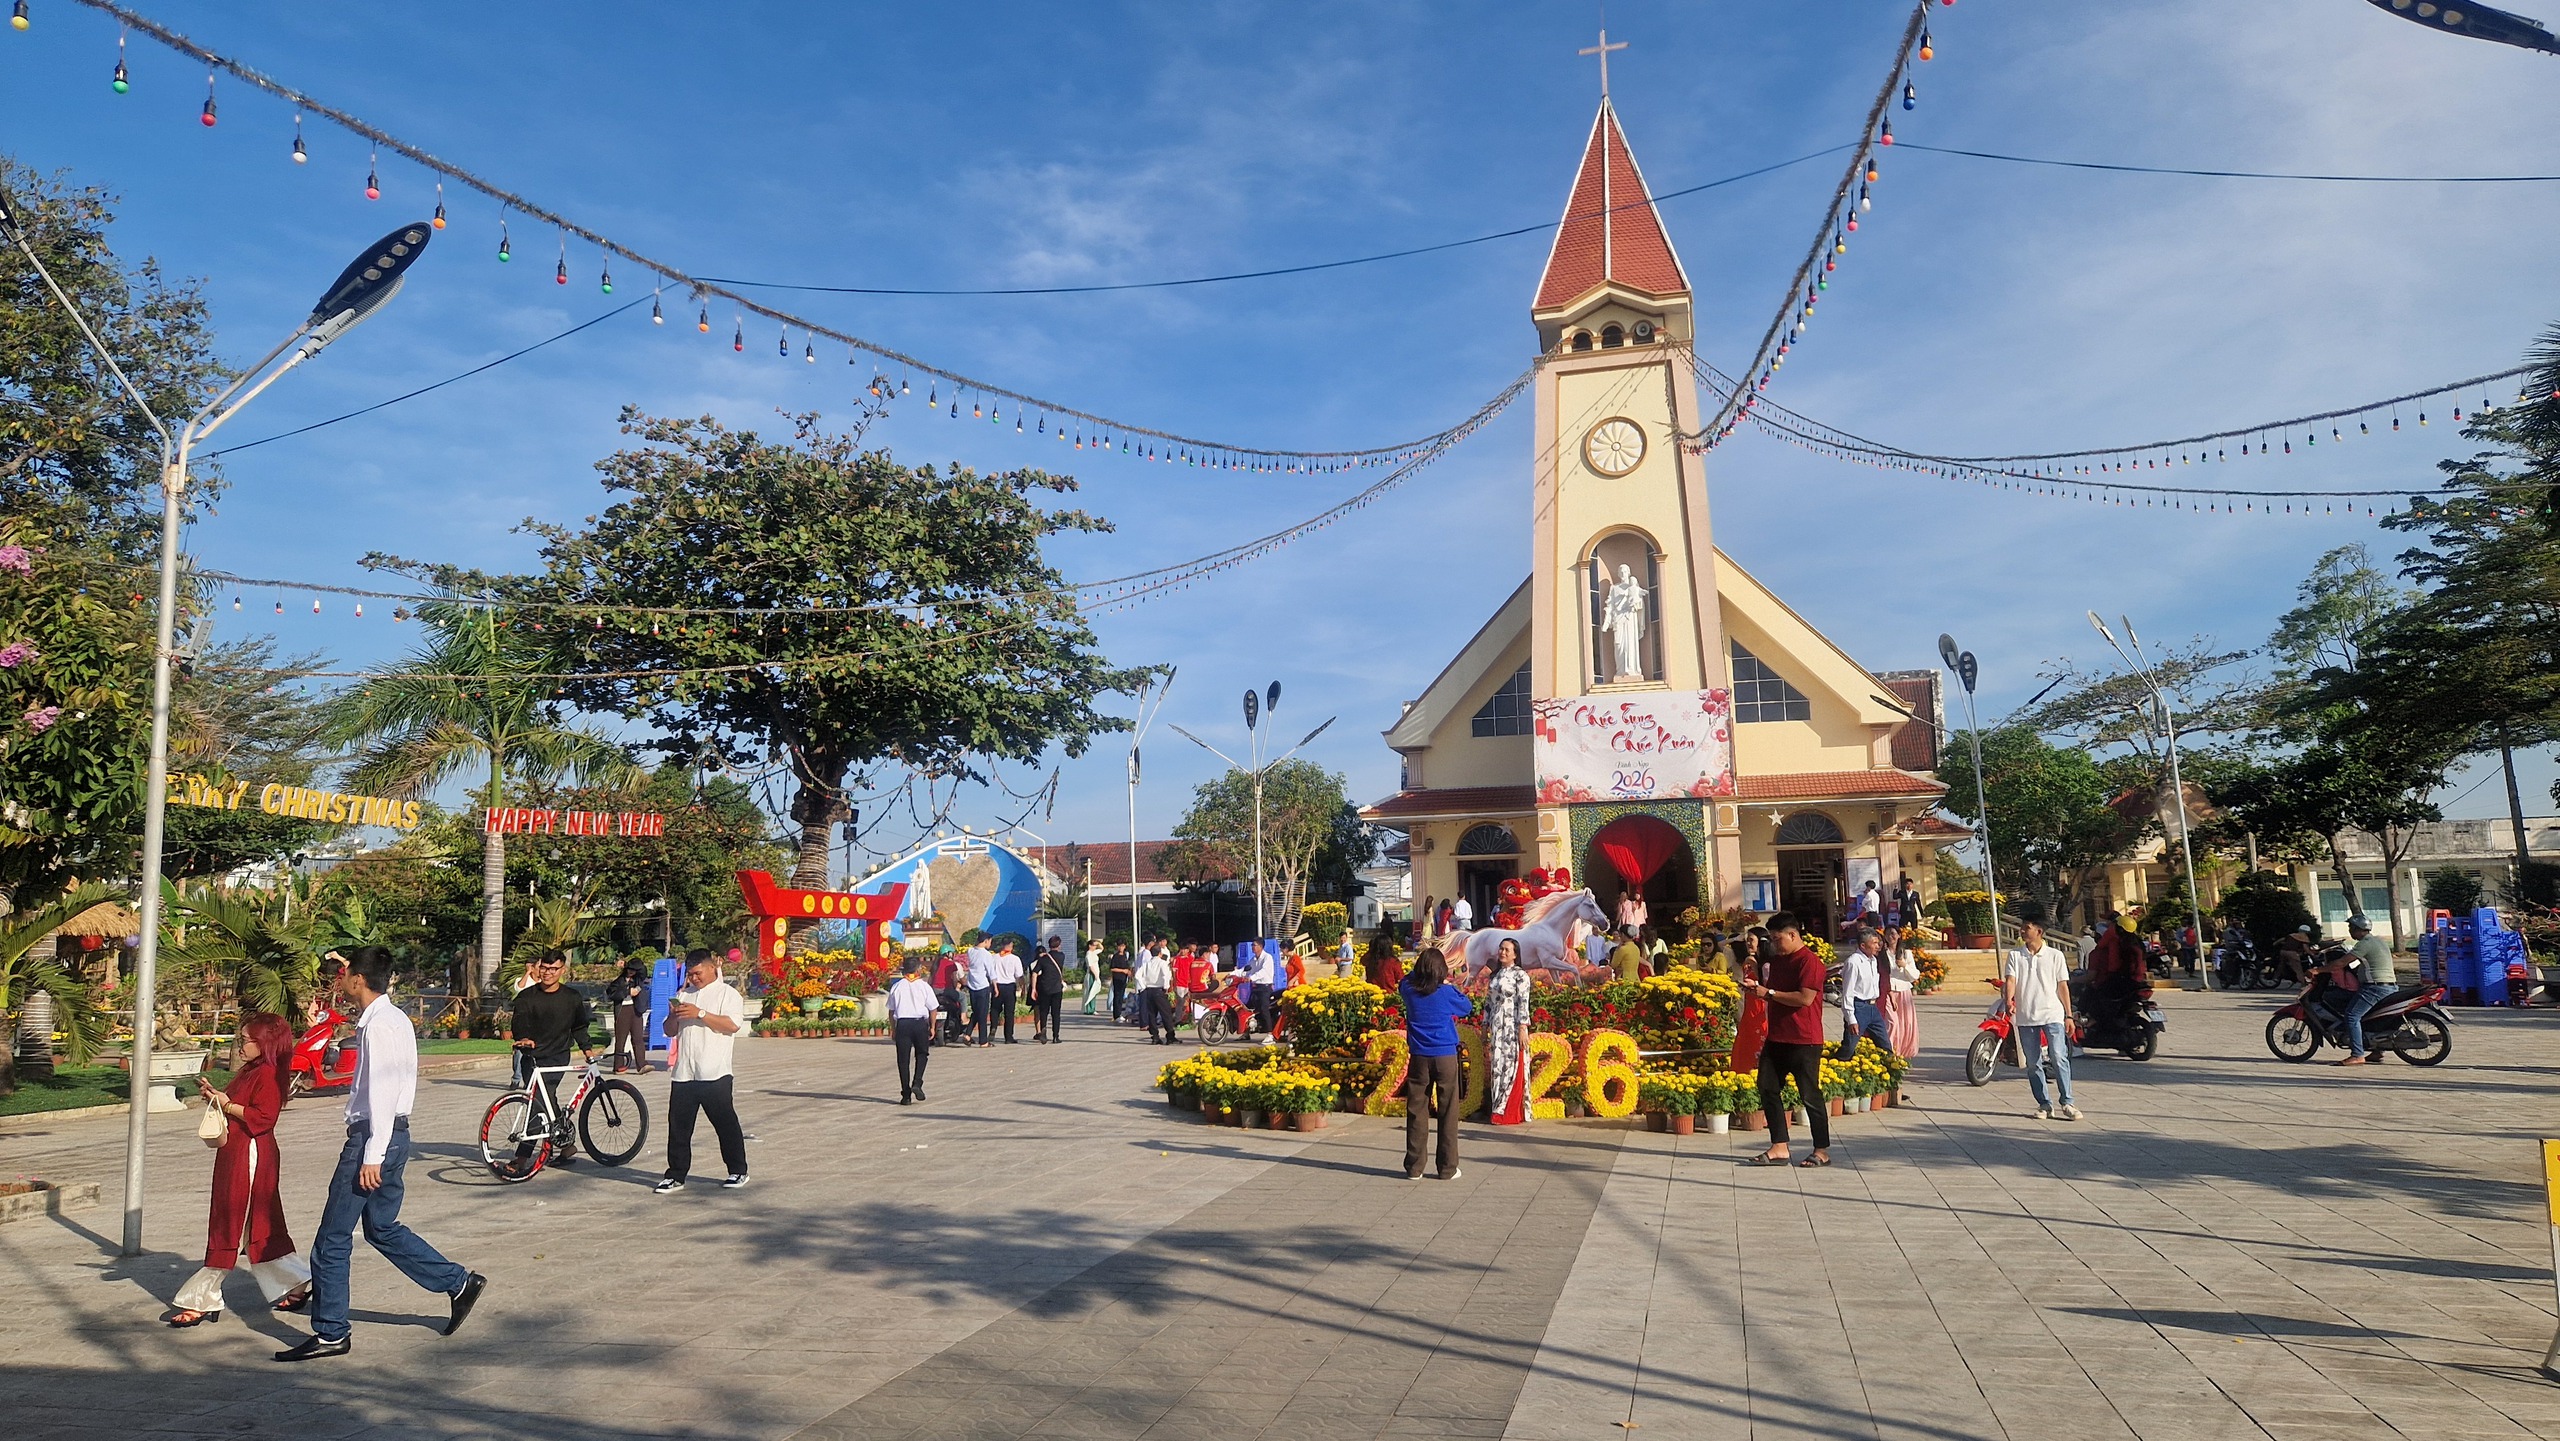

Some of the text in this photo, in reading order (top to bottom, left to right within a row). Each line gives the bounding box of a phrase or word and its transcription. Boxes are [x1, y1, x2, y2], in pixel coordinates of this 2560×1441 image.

[1574, 703, 1617, 730] Chúc
[1610, 768, 1655, 792] 2026
[261, 783, 421, 829] CHRISTMAS
[485, 807, 665, 837] HAPPY NEW YEAR
